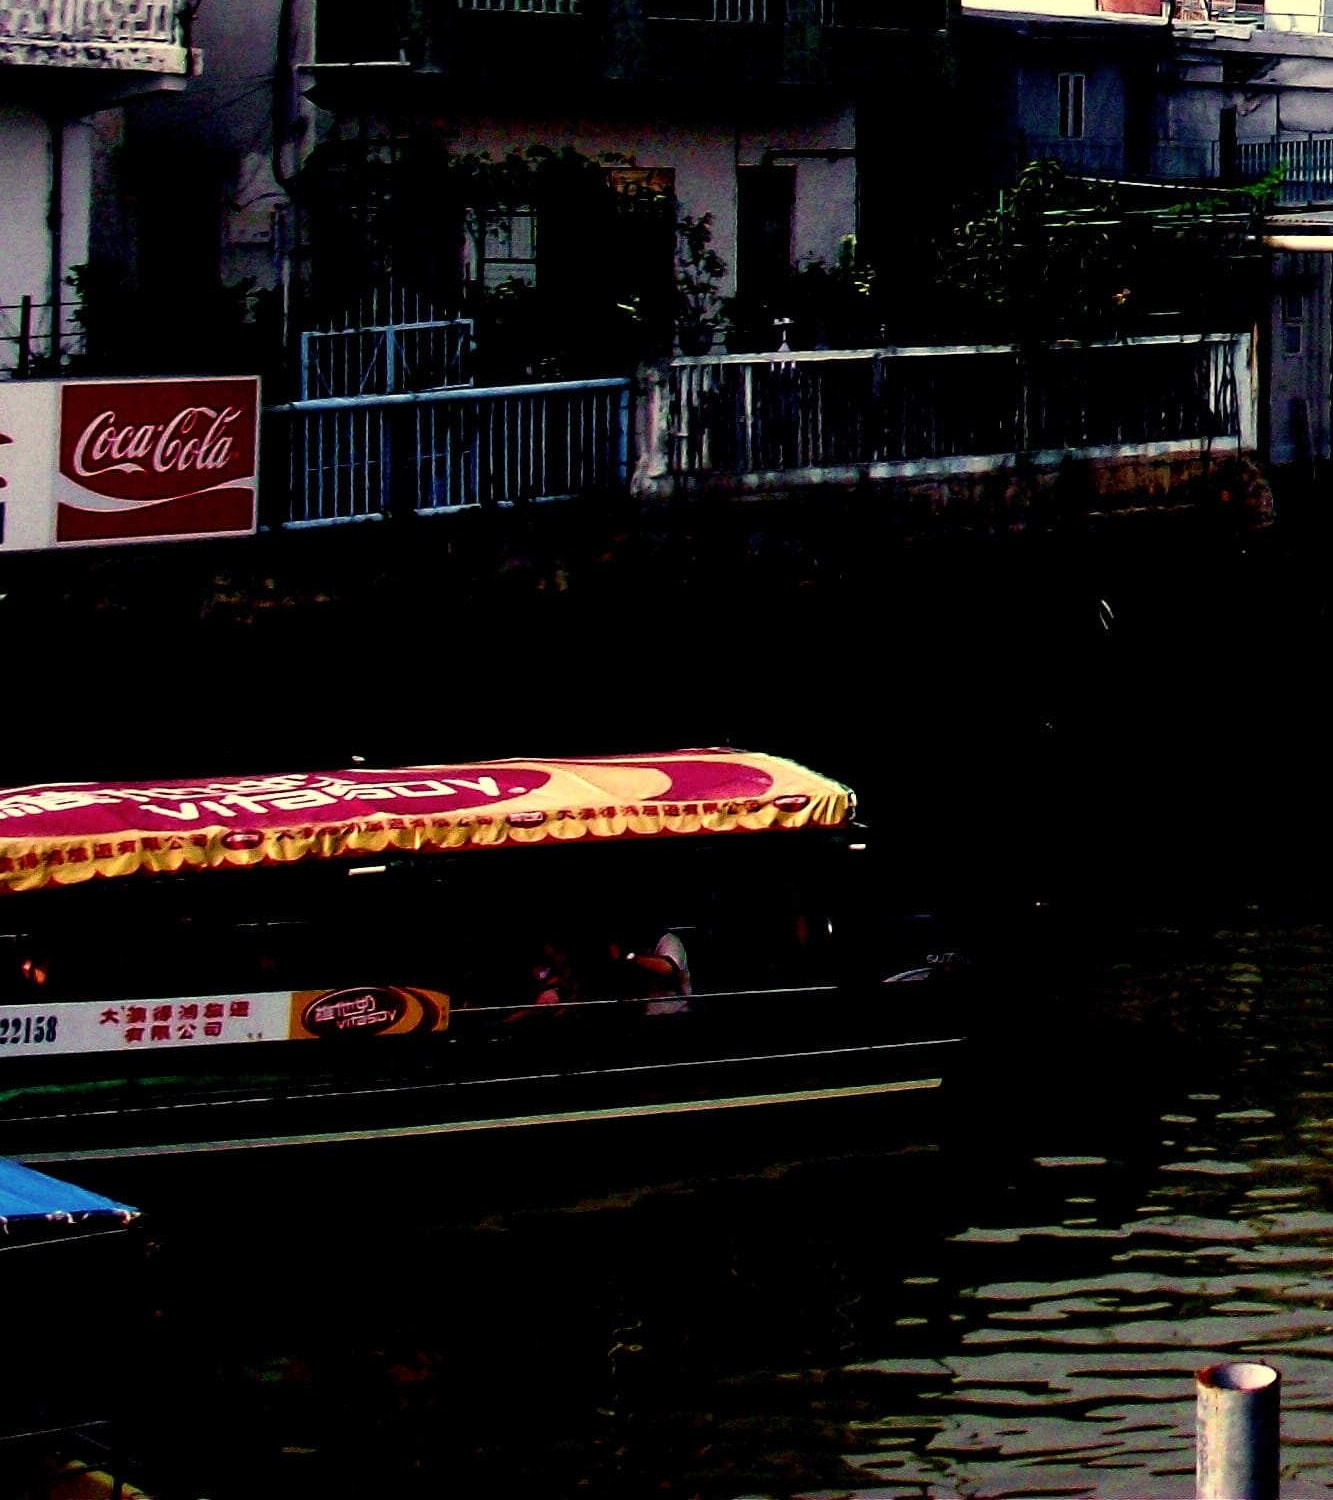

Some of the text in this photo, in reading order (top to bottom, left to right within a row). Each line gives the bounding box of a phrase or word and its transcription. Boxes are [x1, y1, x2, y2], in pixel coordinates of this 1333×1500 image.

[74, 406, 247, 477] Coca-Cola
[125, 1021, 222, 1043] 有限公司
